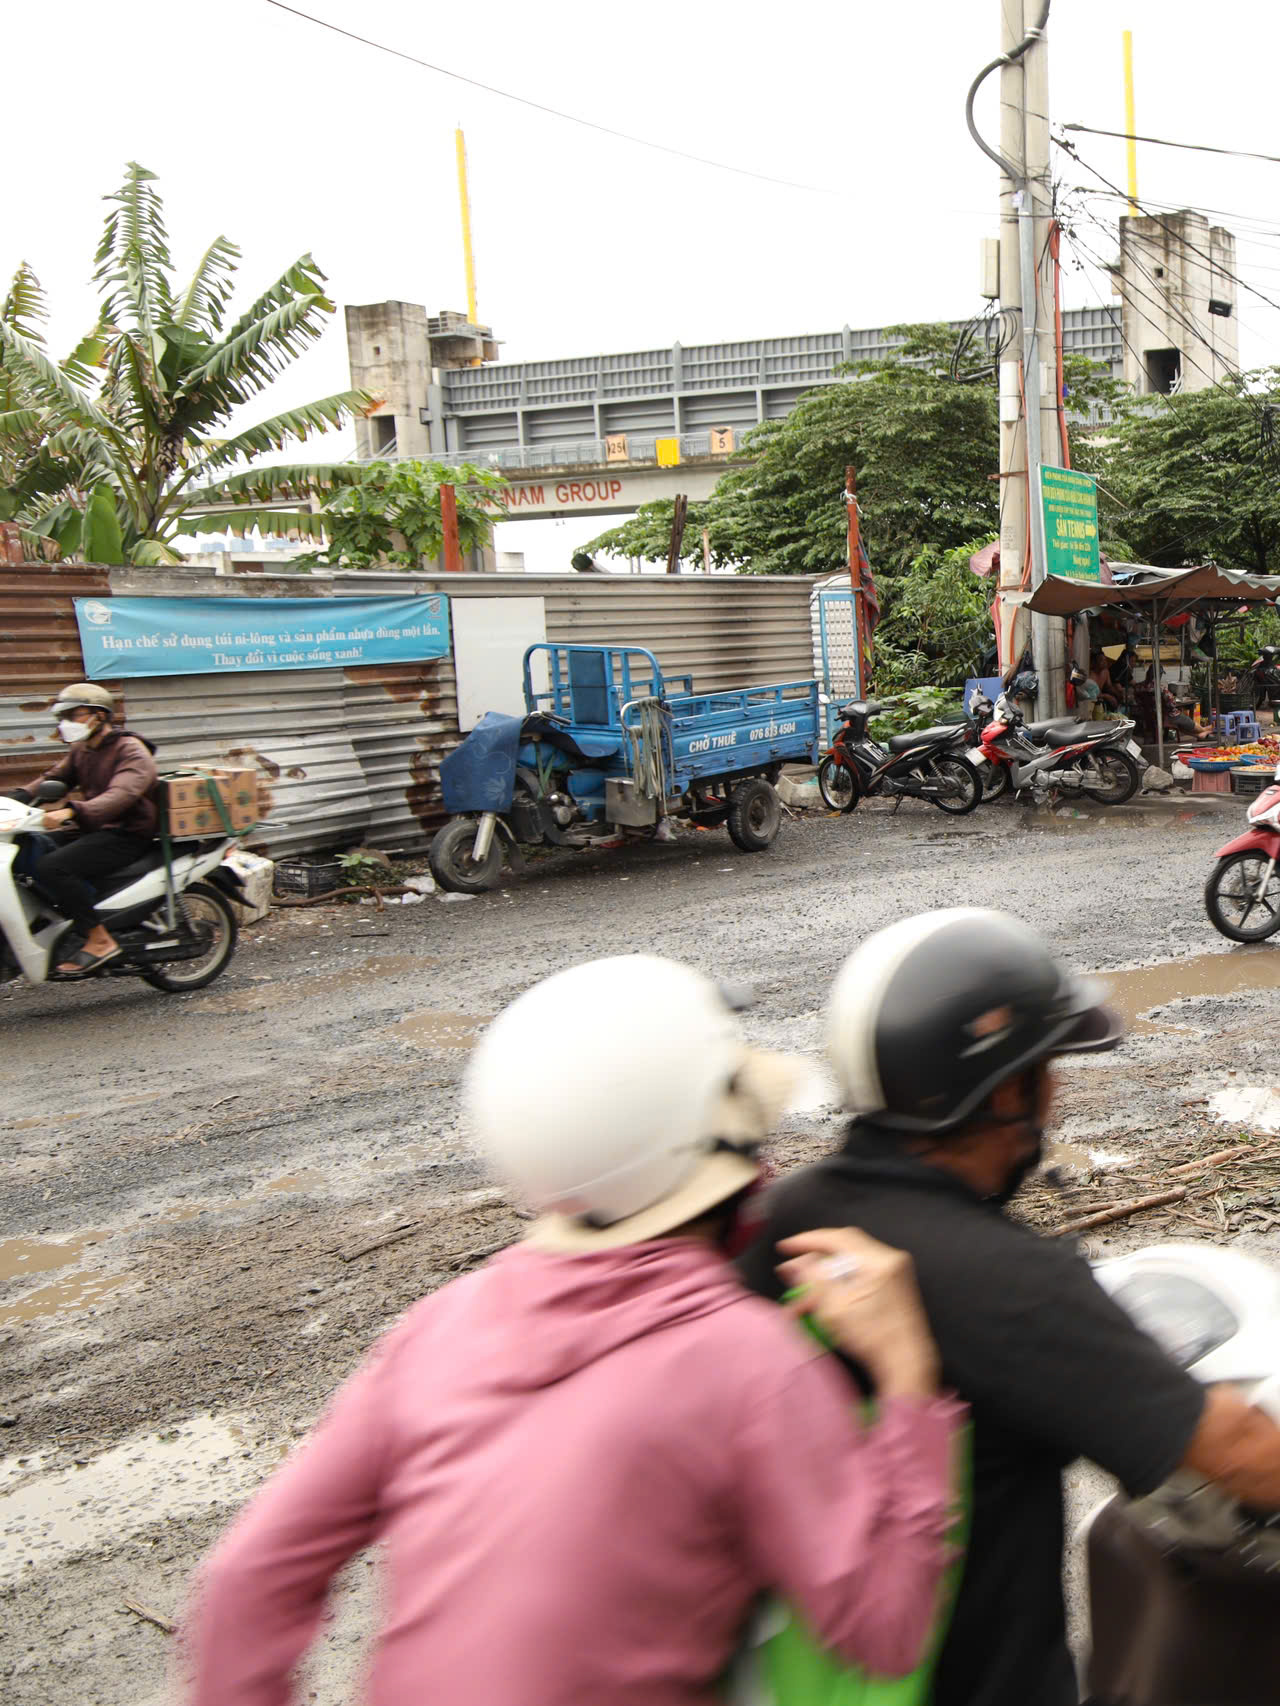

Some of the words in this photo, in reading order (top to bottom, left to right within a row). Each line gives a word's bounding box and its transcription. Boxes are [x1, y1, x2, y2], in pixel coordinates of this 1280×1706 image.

[611, 443, 622, 454] 25
[718, 438, 726, 448] 5
[555, 480, 622, 504] GROUP
[101, 634, 133, 650] Hạn
[135, 632, 160, 648] chế
[162, 632, 179, 647] sử
[181, 633, 213, 649] dụng
[215, 632, 233, 646] túi
[235, 630, 276, 647] ni-lông
[278, 630, 292, 644] và
[294, 628, 314, 643] sản
[316, 627, 346, 645] phẩm
[348, 628, 374, 642] nhựa
[376, 625, 401, 641] dùng
[402, 624, 421, 639] một
[423, 622, 441, 636] lần.
[212, 652, 242, 667] Thay
[245, 648, 264, 665] đổi
[267, 649, 278, 664] vì
[279, 650, 305, 665] cuộc
[307, 646, 332, 664] sống
[334, 646, 363, 660] xanh!
[689, 734, 710, 752] CHỞ
[711, 731, 737, 749] THUÊ
[749, 729, 763, 741] 076
[779, 721, 796, 735] 4504
